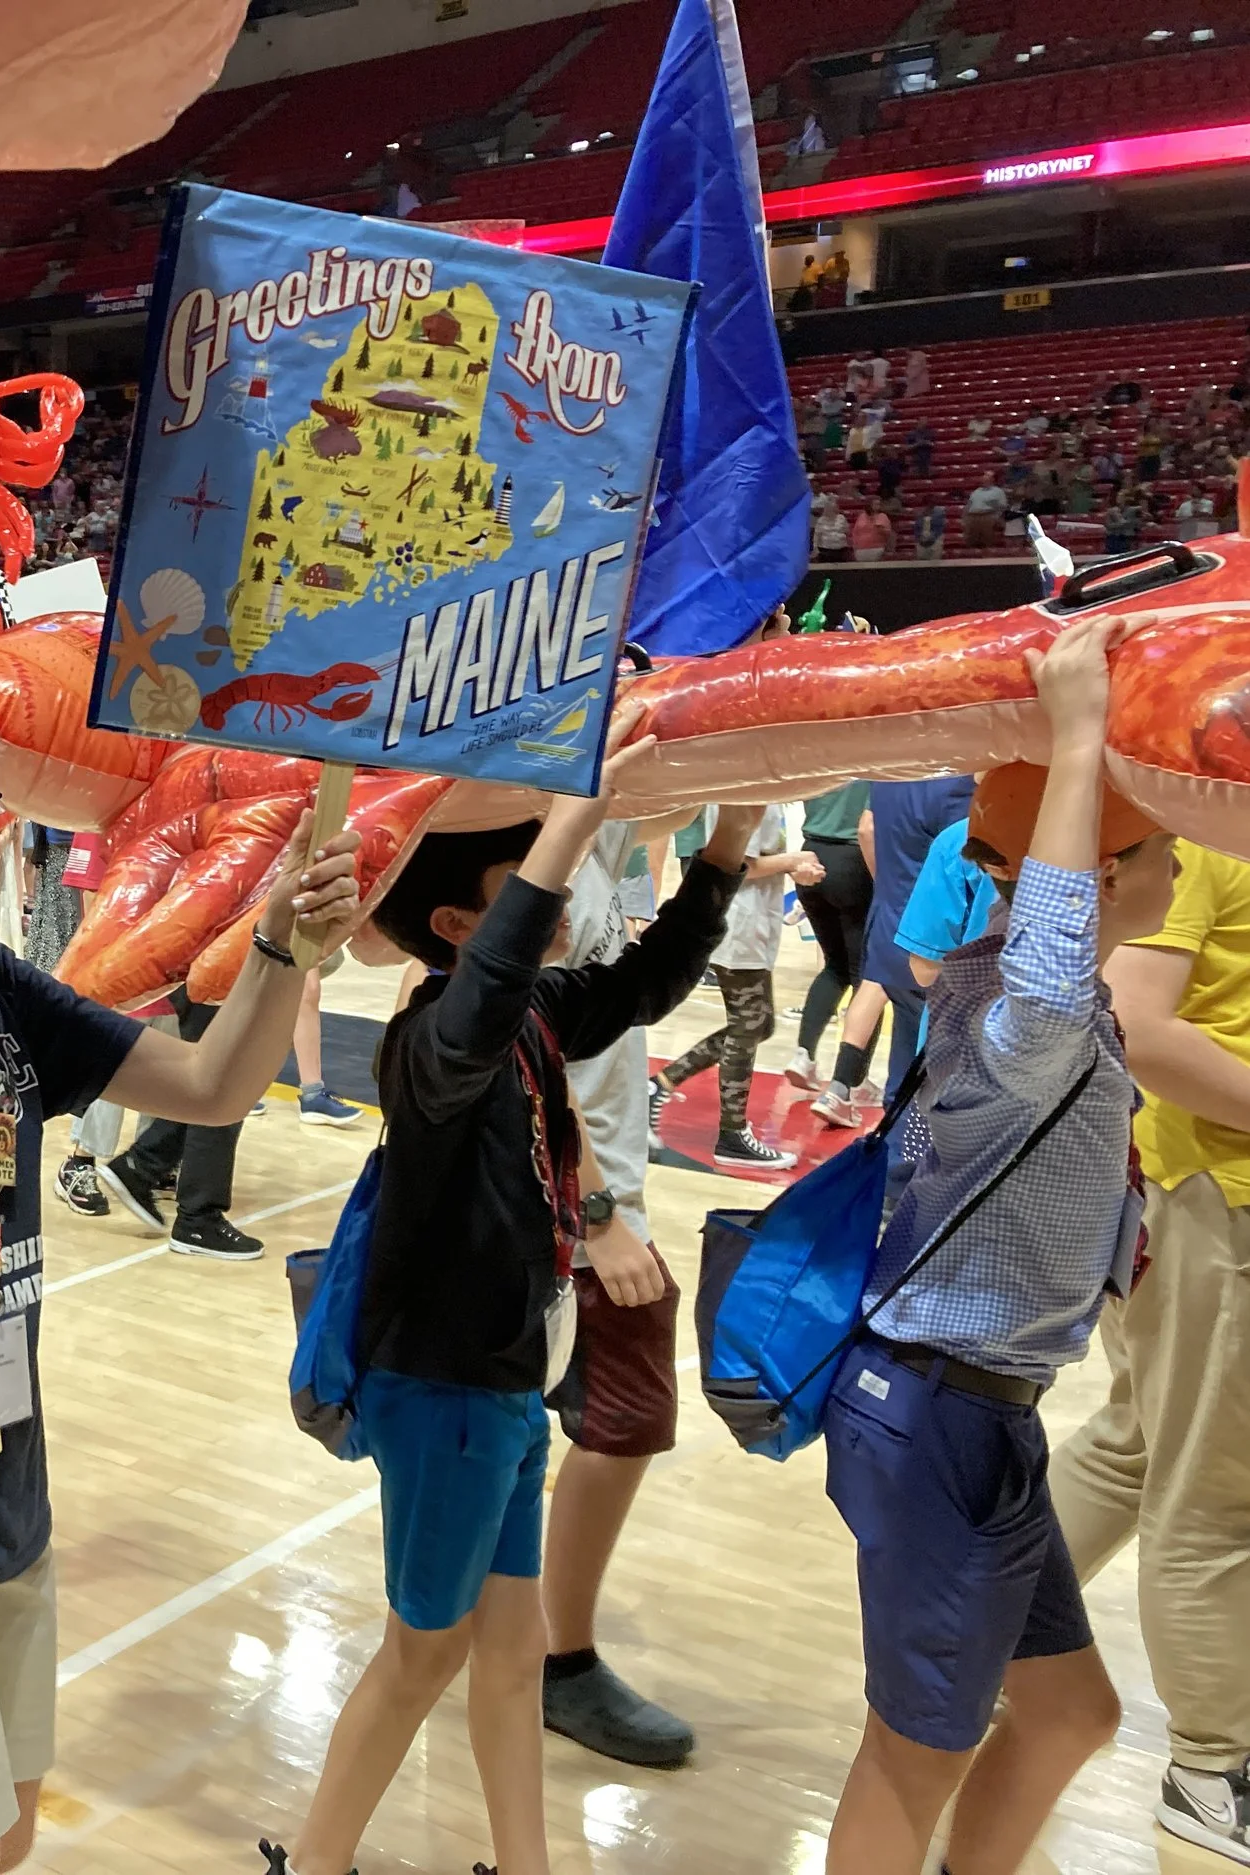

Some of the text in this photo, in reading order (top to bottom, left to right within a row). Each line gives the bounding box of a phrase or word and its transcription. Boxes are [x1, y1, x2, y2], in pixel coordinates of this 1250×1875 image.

[985, 154, 1094, 184] HISTORYNET
[162, 246, 433, 434] Greetings
[383, 541, 627, 752] MAINE
[473, 710, 523, 737] THE WAY
[460, 736, 484, 755] LIFE
